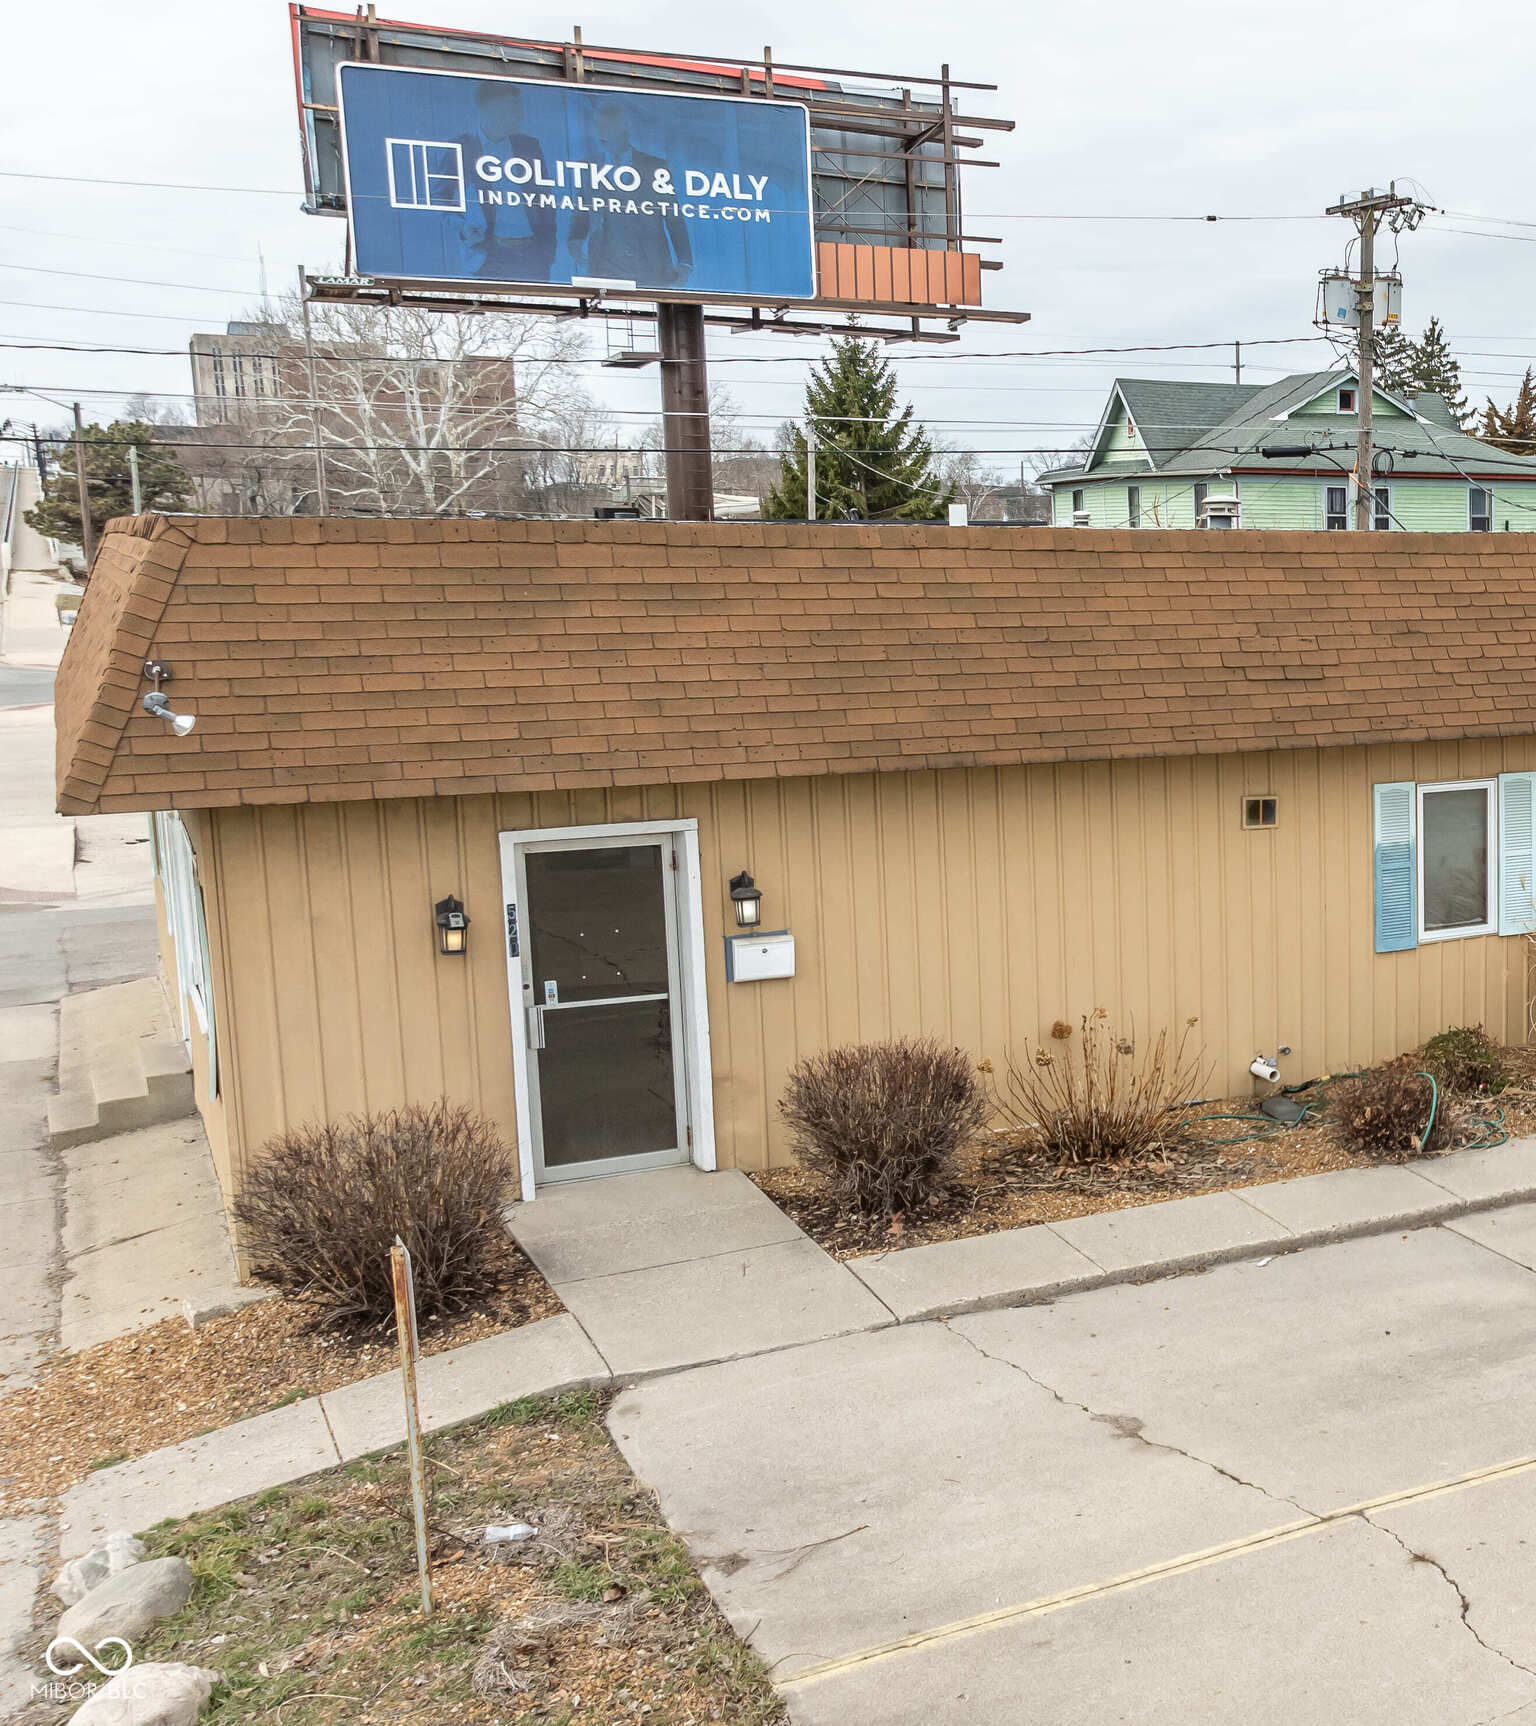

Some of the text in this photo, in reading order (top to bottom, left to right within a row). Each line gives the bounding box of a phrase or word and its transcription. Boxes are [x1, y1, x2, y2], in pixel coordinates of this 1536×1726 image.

[475, 155, 769, 201] GOLITKO & DALY
[478, 189, 771, 224] INDYMALPRACTICE.COM
[318, 276, 370, 286] LAMAR
